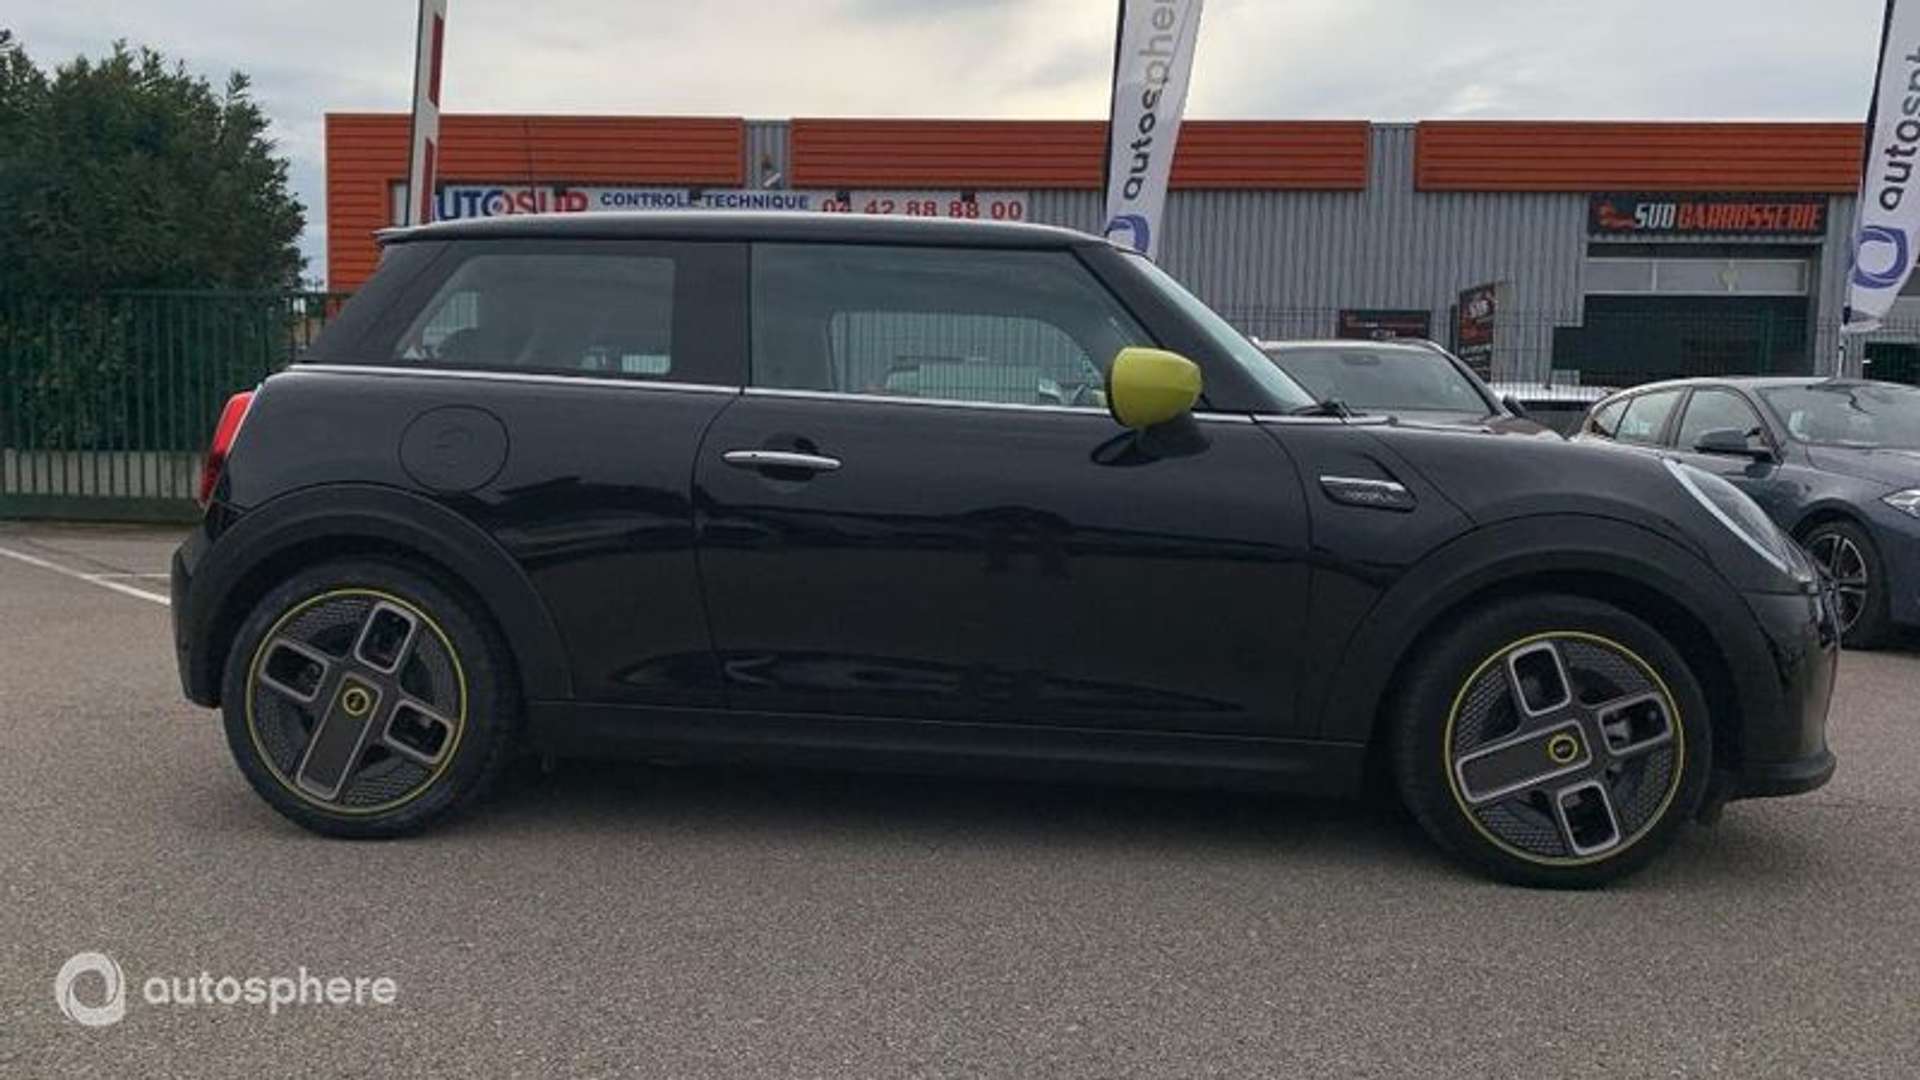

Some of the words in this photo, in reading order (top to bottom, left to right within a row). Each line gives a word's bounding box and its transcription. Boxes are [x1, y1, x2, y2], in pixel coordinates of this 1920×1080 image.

[1123, 0, 1176, 201] autosphe
[704, 193, 809, 210] TECHNIQUE
[864, 199, 895, 215] 42
[906, 199, 938, 217] 88
[949, 199, 980, 219] 88
[991, 200, 1023, 220] 00
[1634, 202, 1677, 229] SUD
